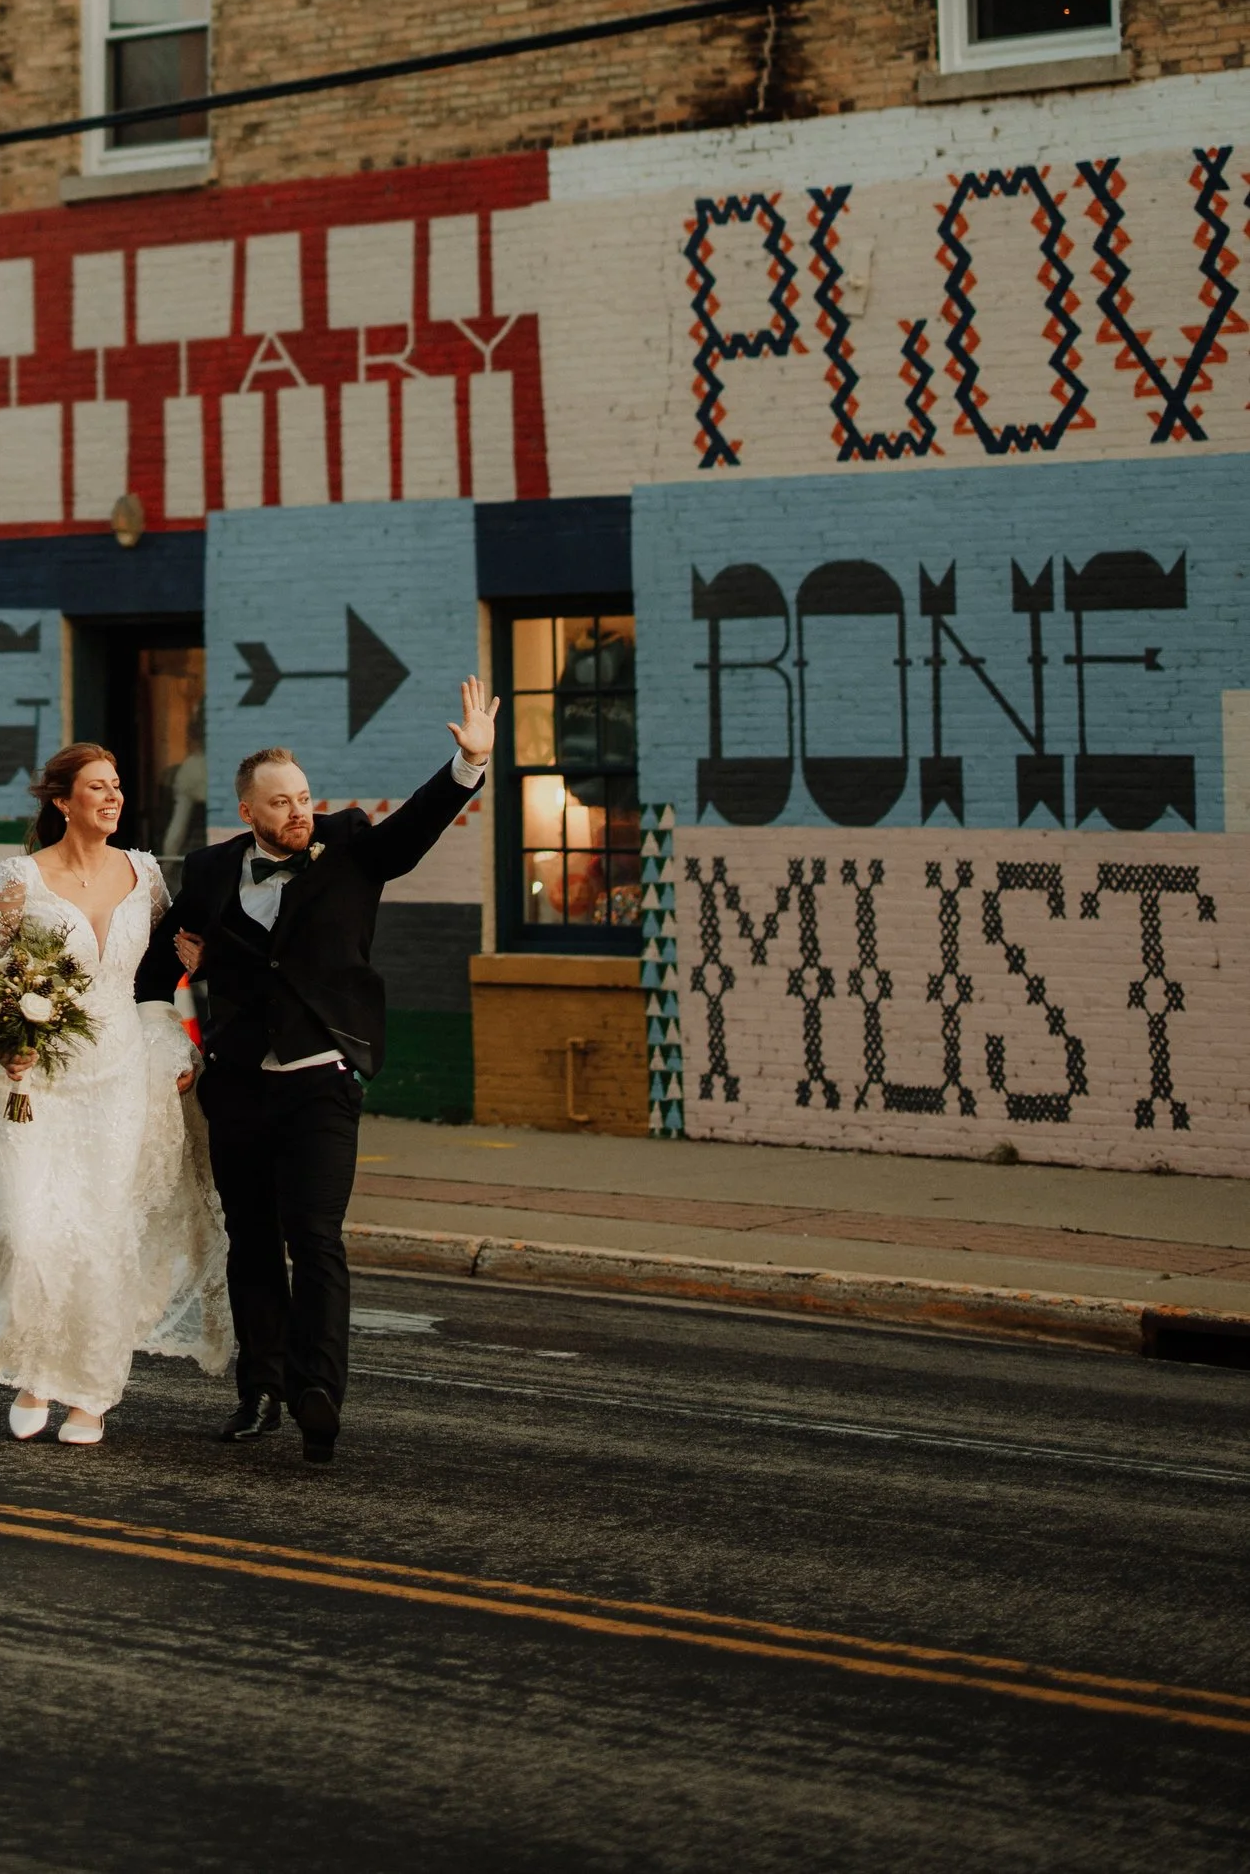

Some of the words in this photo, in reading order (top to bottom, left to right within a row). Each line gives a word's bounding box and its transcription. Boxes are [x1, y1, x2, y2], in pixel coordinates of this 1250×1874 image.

[684, 144, 1250, 468] PLOV
[691, 548, 1198, 830] BONE
[684, 855, 1219, 1131] MUST
